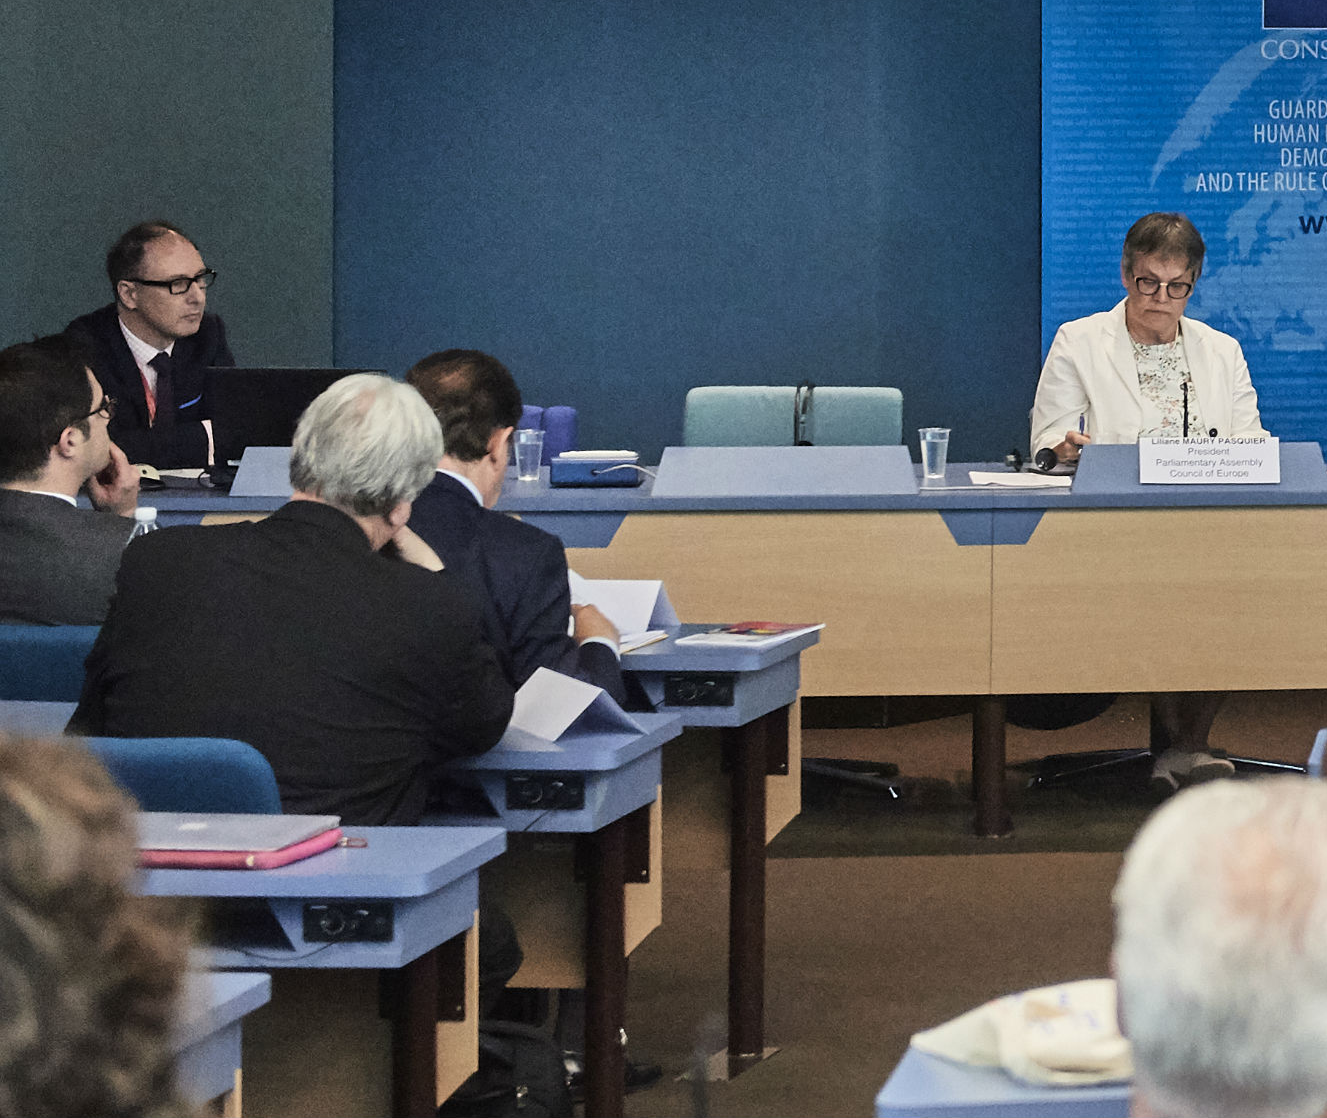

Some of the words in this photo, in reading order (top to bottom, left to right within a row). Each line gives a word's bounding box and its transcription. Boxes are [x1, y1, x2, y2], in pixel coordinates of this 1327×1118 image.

[1253, 123, 1320, 143] HUMAN
[1196, 172, 1233, 193] AND
[1237, 172, 1269, 192] THE
[1273, 172, 1316, 192] RULE
[1151, 437, 1180, 445] Liliane
[1183, 437, 1216, 445] MAURY
[1218, 437, 1266, 445] PASQUIER
[1187, 447, 1230, 456] President
[1156, 458, 1217, 468] Parliamentary
[1219, 458, 1264, 468] Assembly
[1169, 469, 1204, 478] Council
[1205, 469, 1215, 478] of
[1217, 469, 1249, 479] Europe
